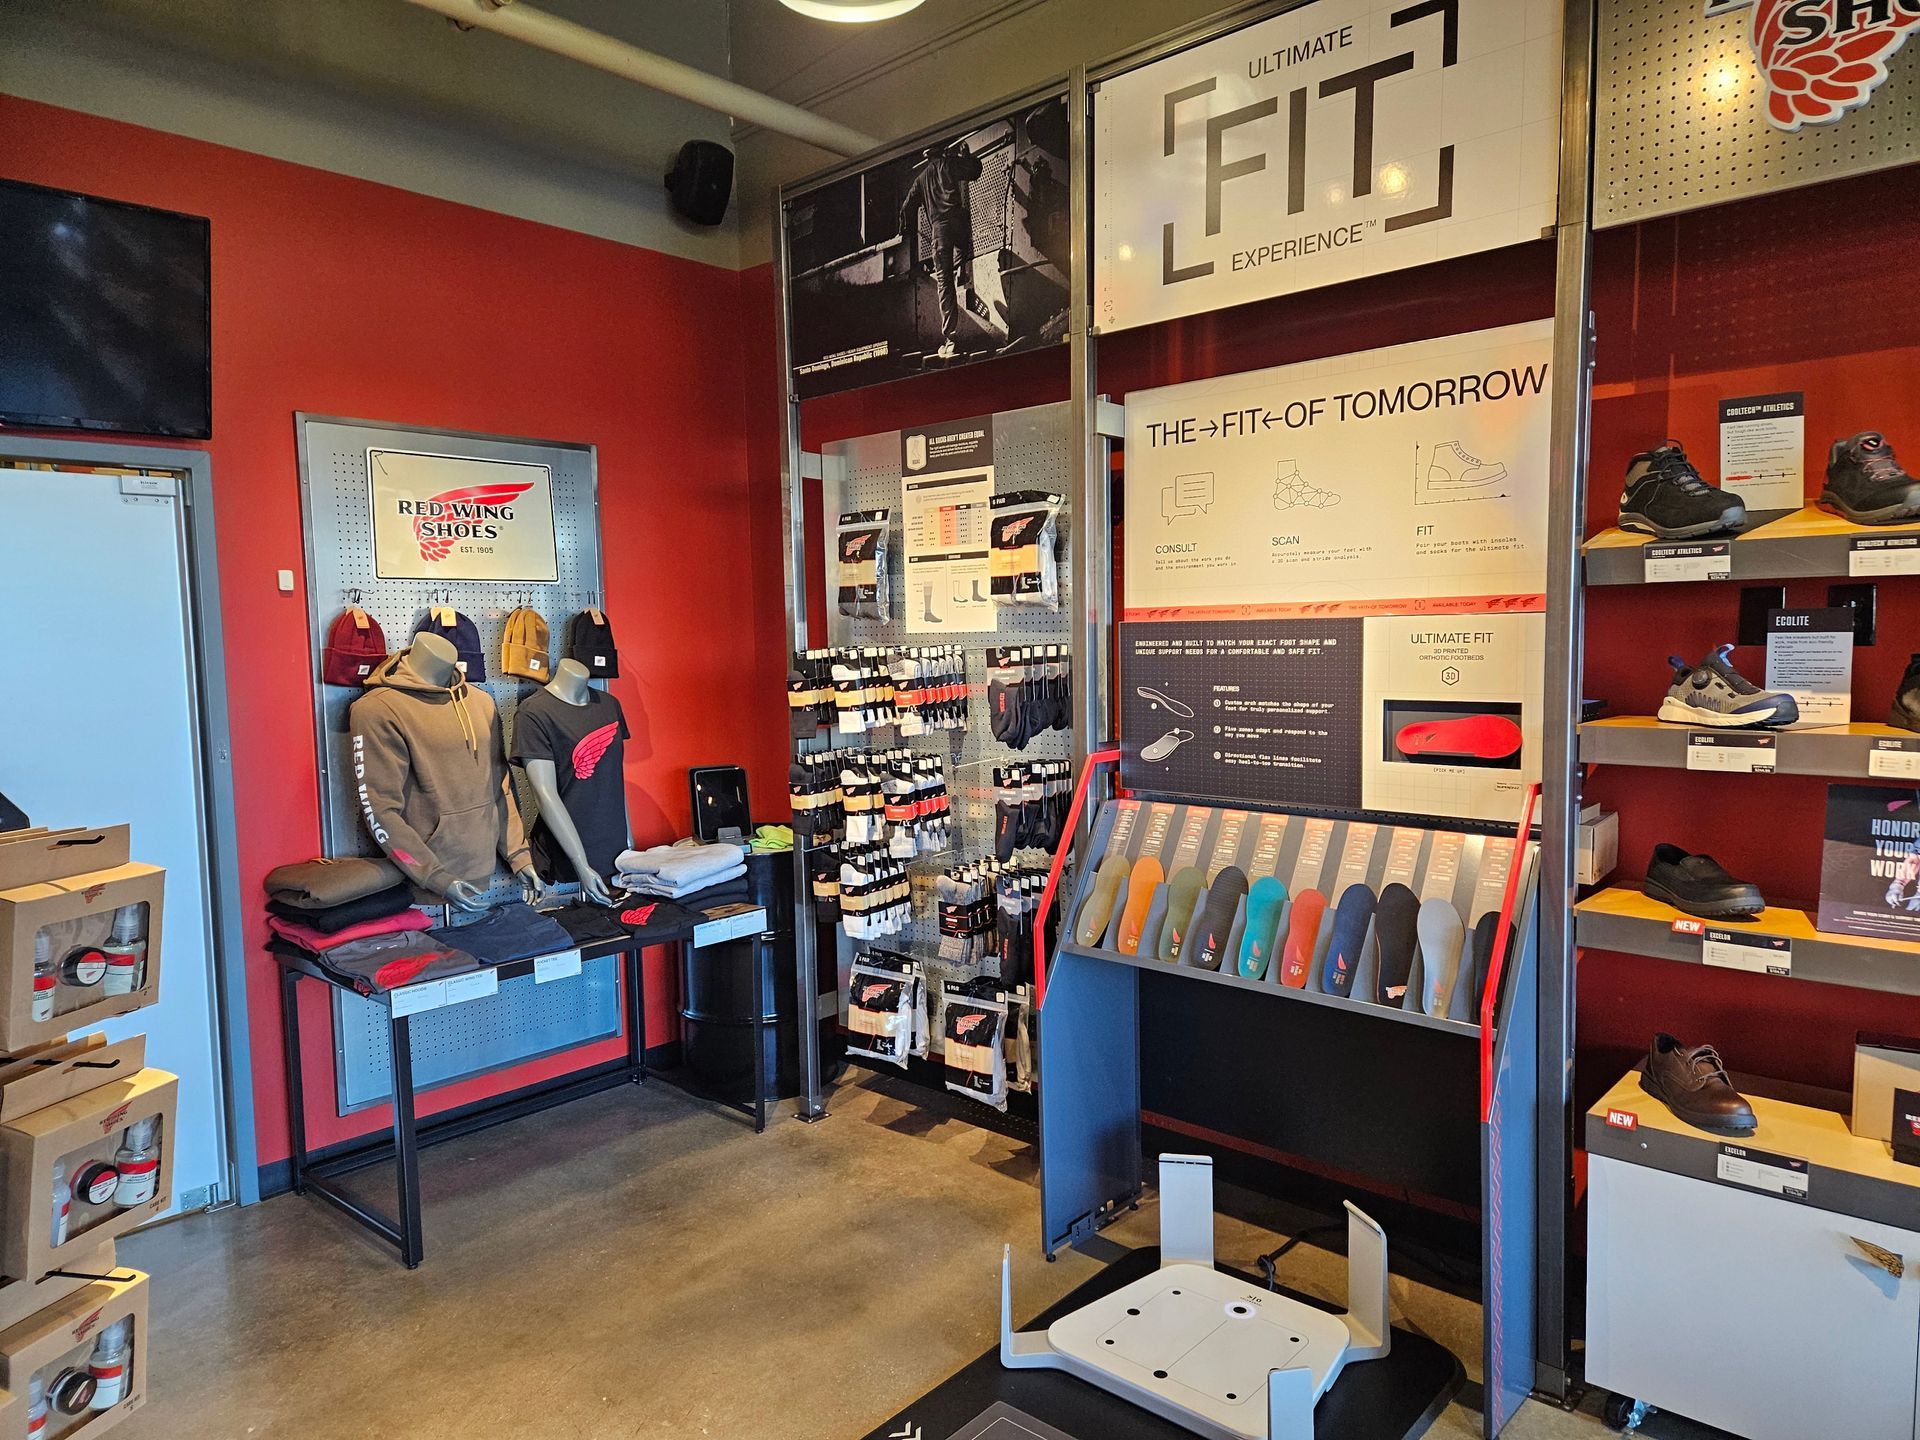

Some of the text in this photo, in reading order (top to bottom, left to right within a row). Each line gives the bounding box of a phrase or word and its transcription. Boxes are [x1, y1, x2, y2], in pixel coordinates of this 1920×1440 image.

[1248, 25, 1353, 79] ULTIMATE
[1205, 51, 1414, 236] FIT
[1146, 364, 1548, 447] THE FIT OF TOMORROW
[1762, 402, 1794, 412] ATHLETICS
[398, 500, 514, 520] RED WING
[1416, 525, 1434, 536] FIT
[1272, 536, 1300, 546] SCAN
[1156, 543, 1198, 554] CONSULT
[1776, 616, 1810, 626] ECOLITE
[1411, 632, 1494, 644] ULTIMATE FIT
[1446, 672, 1456, 680] 3D
[352, 735, 364, 779] RED
[358, 784, 389, 844] WING
[1675, 920, 1700, 932] NEW
[1610, 1111, 1634, 1127] NEW
